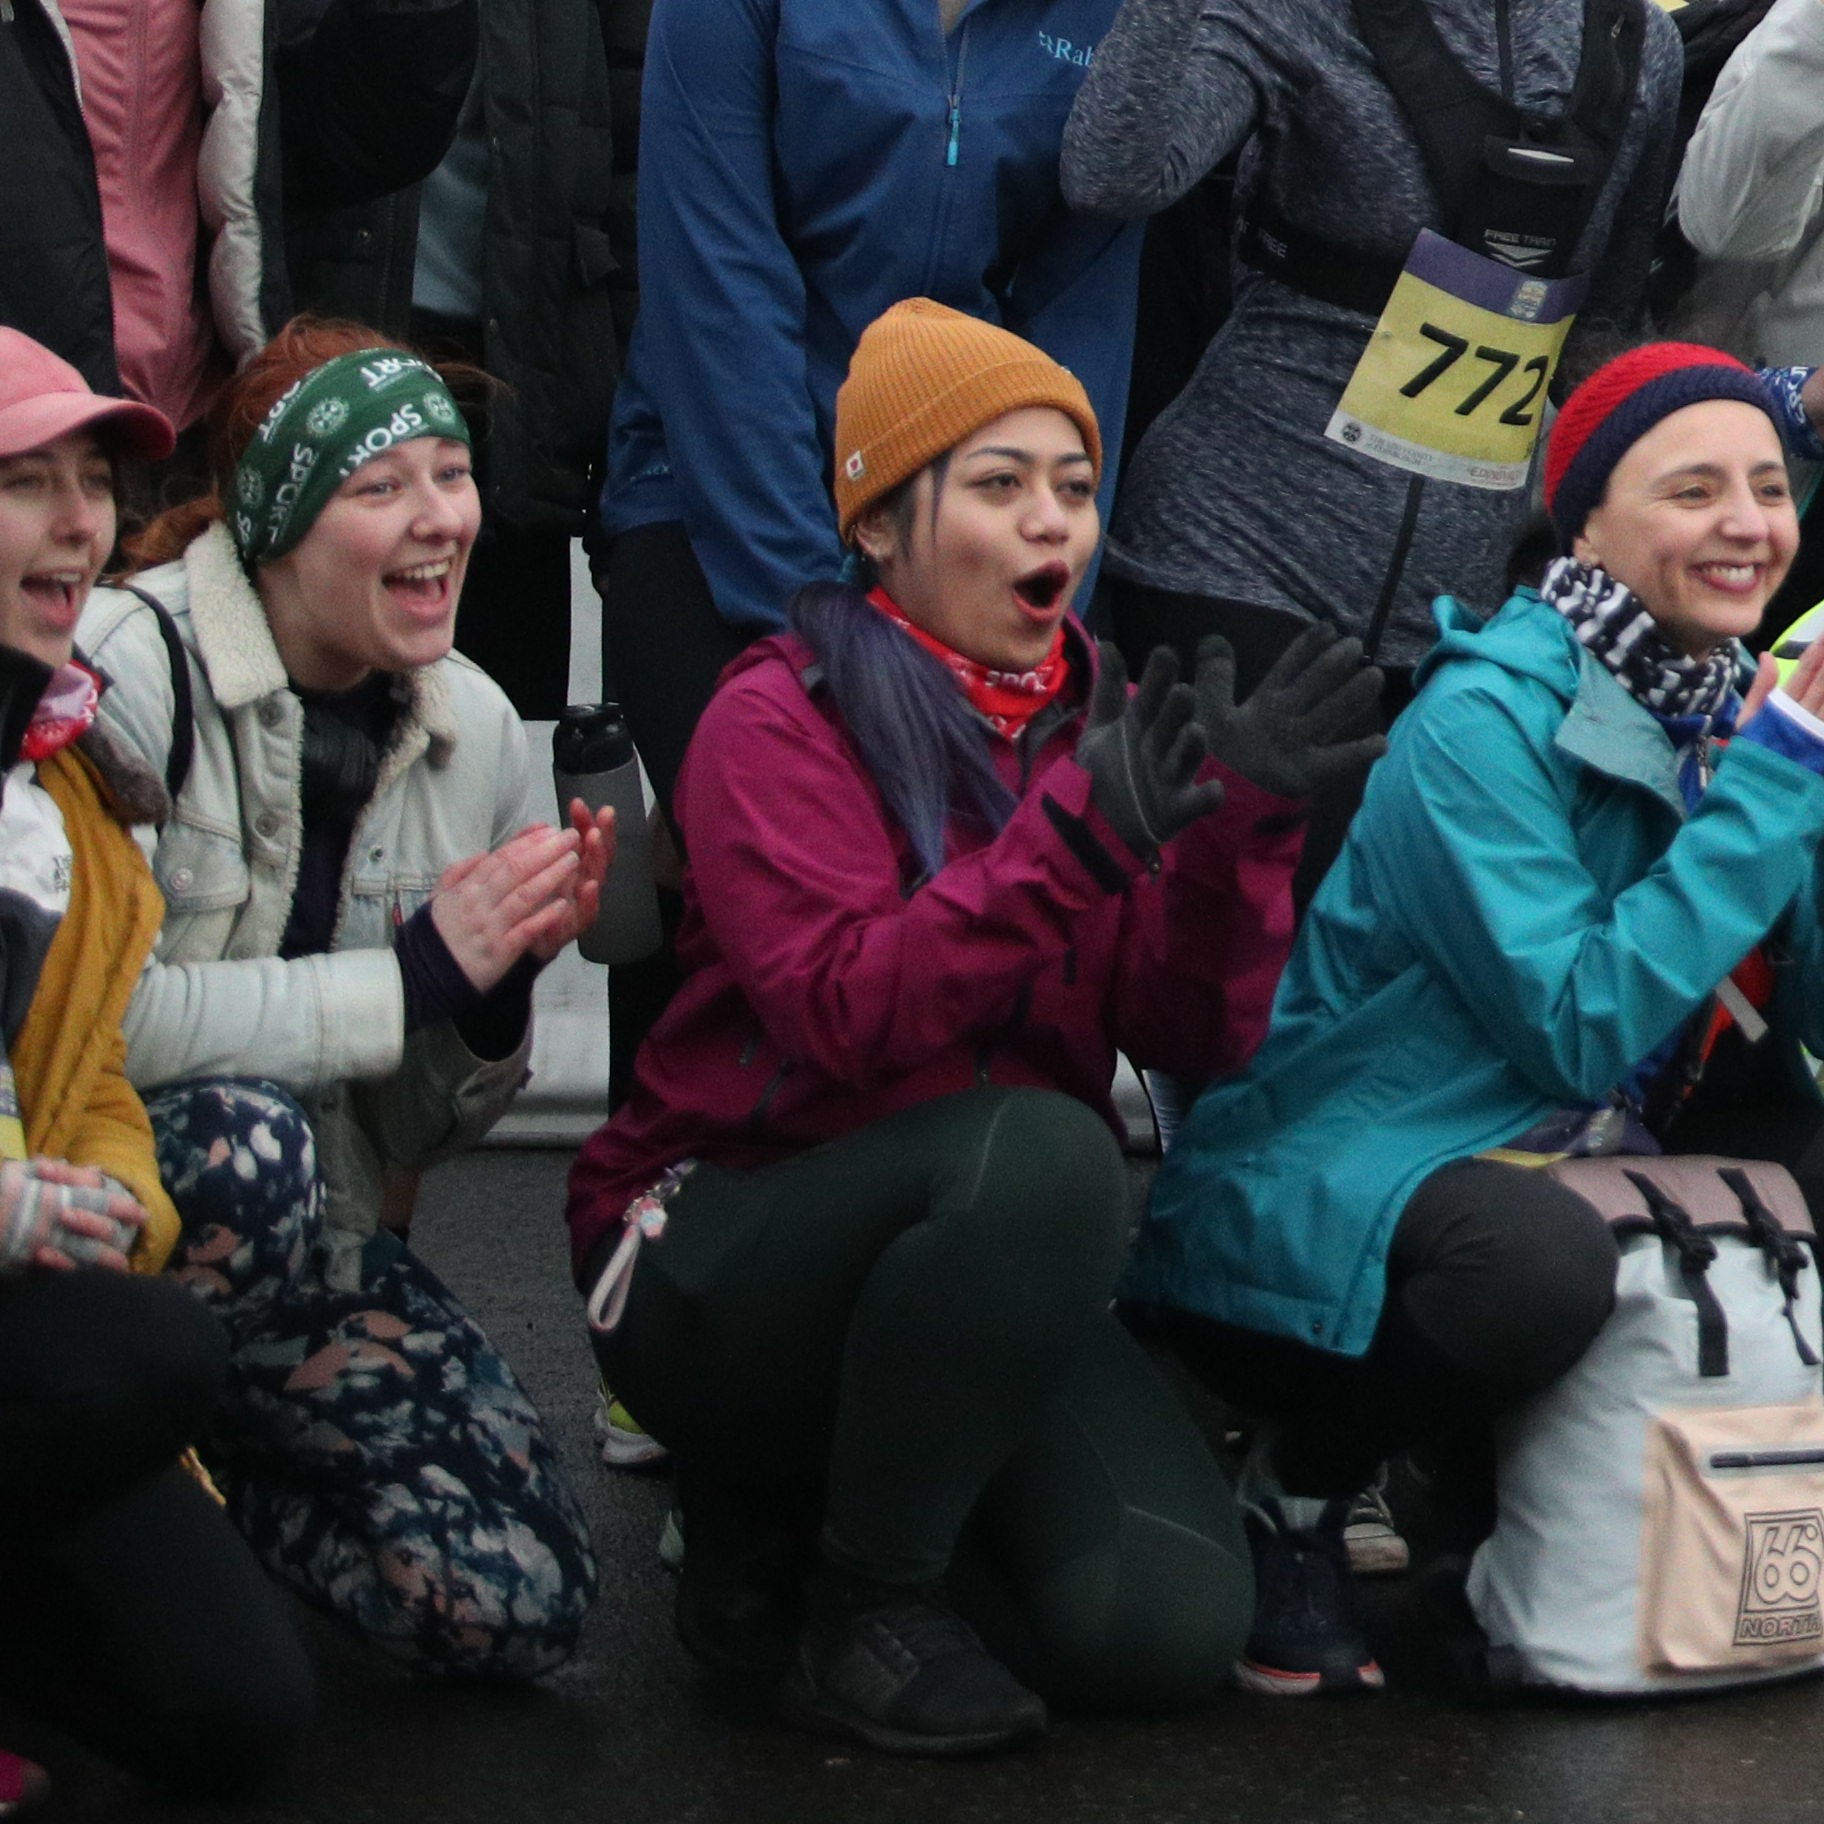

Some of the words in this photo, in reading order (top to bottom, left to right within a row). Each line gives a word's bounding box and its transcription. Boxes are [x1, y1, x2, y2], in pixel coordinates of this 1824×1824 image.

[1399, 322, 1550, 426] 772
[339, 403, 423, 477] SPOR
[1739, 1612, 1824, 1639] NORTH
